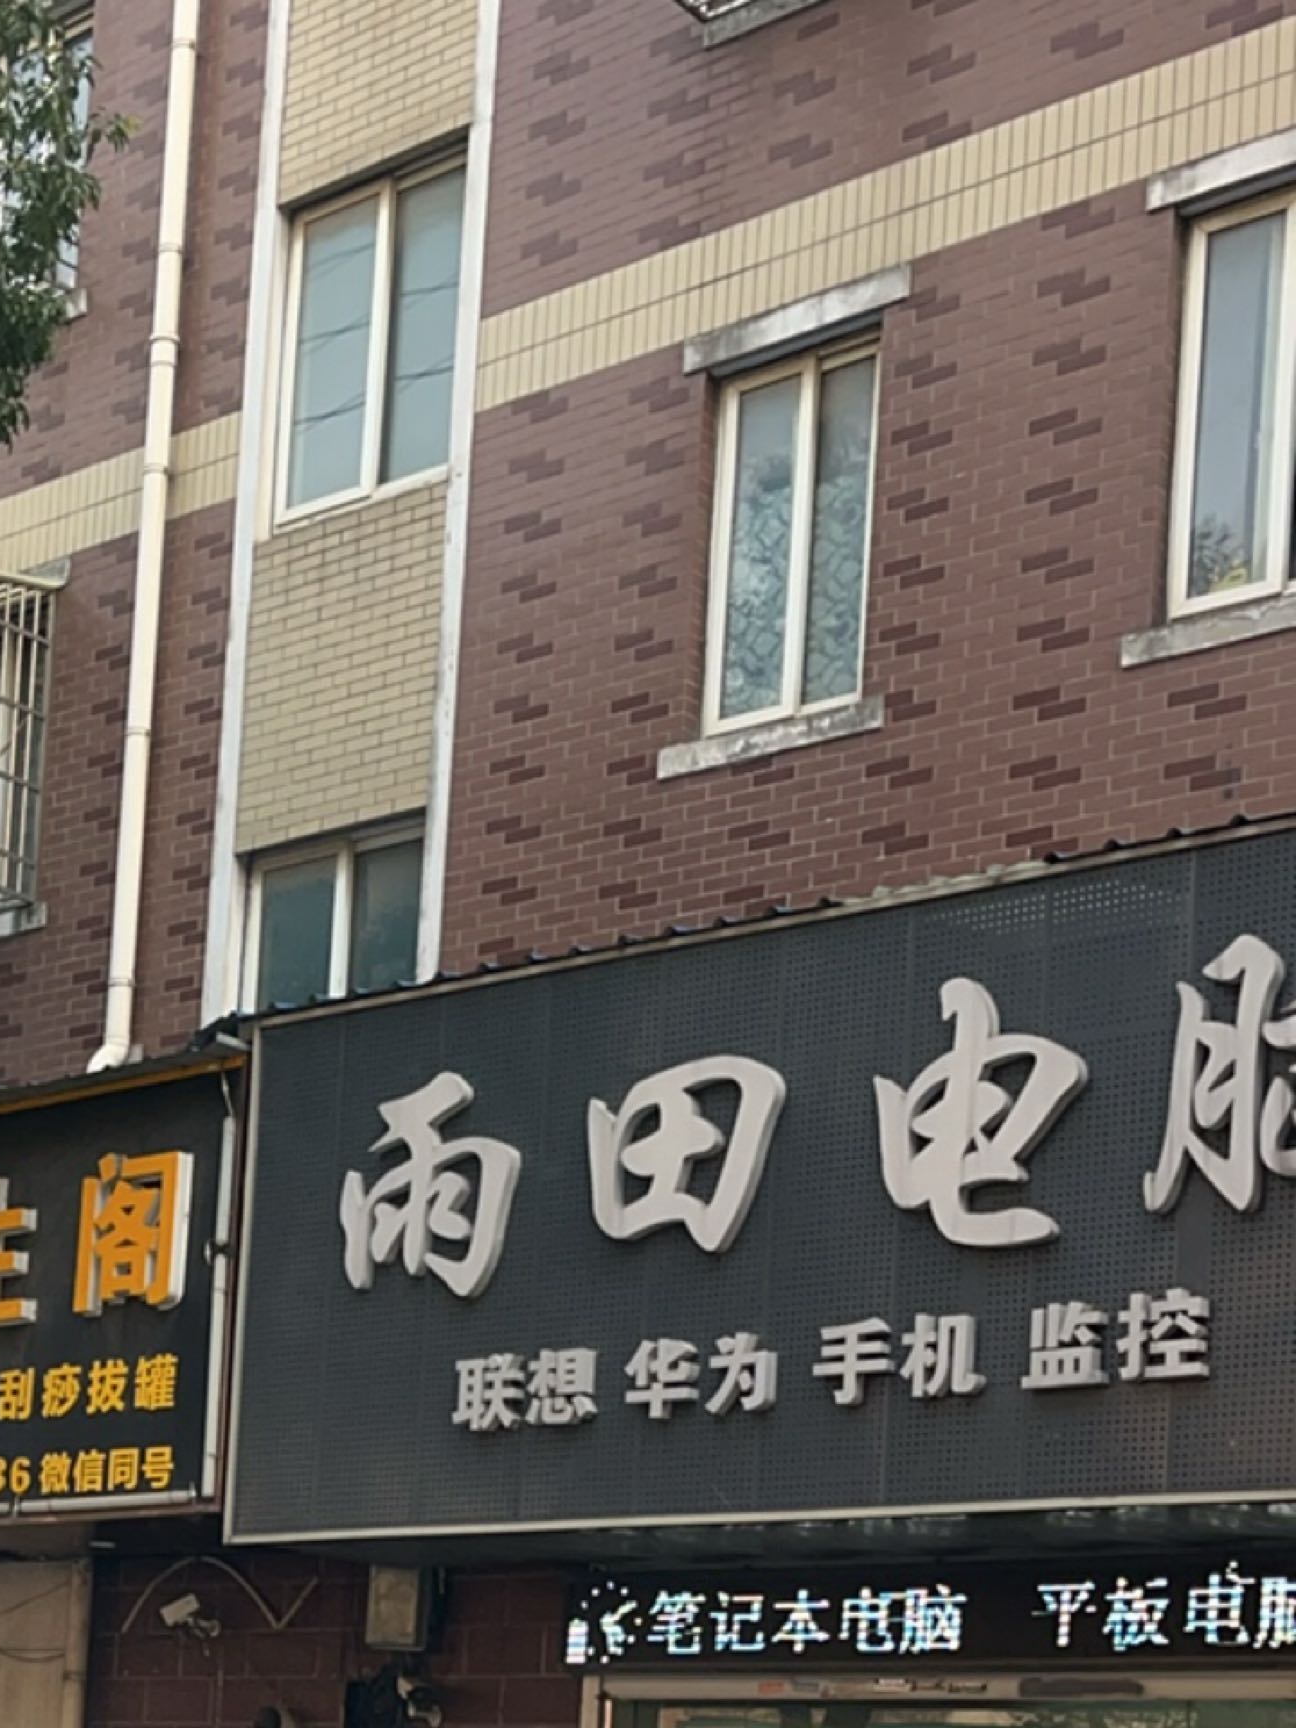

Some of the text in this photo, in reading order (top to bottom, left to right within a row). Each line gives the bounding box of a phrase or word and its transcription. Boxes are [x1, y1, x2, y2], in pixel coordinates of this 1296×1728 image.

[340, 932, 1296, 1300] 雨田电脑
[452, 1287, 1212, 1432] 联想 华为 手机 监控
[647, 1583, 967, 1655] 笔记本电脑
